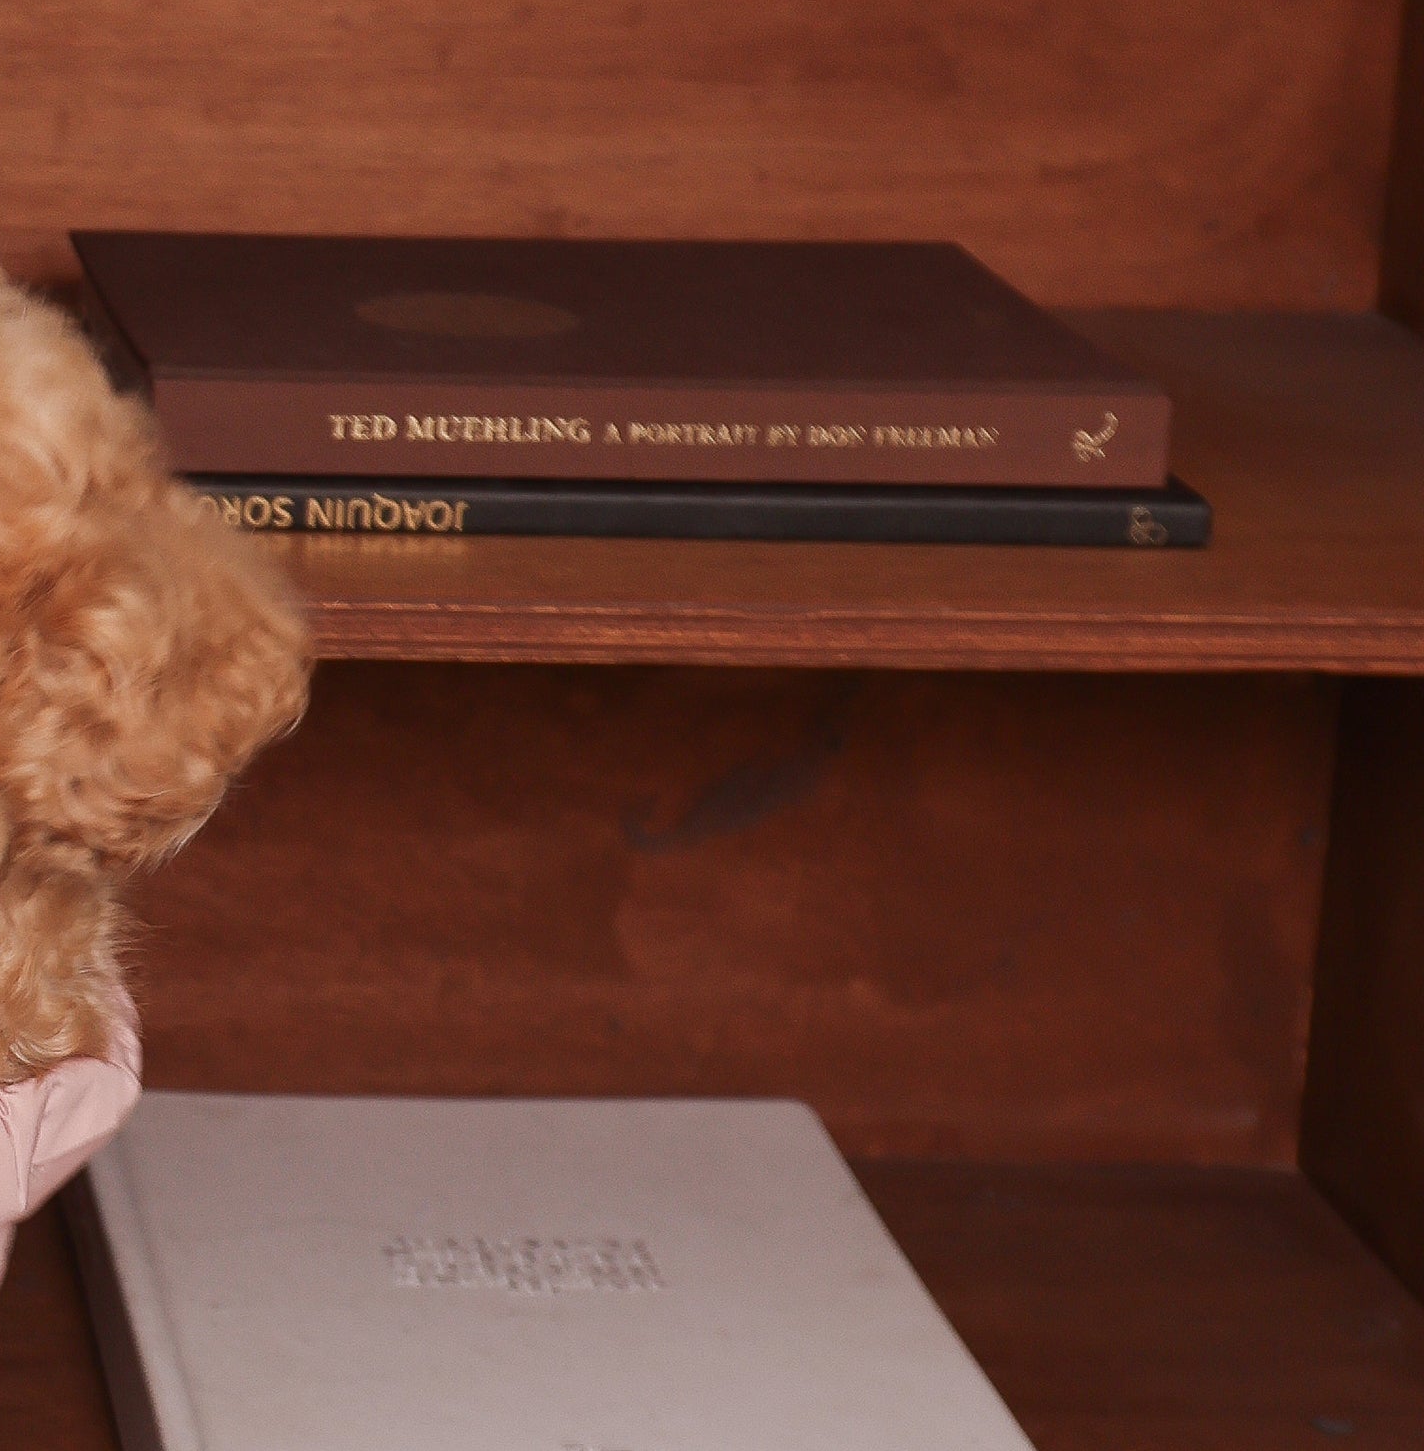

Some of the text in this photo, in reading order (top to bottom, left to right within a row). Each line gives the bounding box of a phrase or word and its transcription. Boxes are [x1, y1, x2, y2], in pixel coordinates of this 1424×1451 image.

[329, 414, 398, 441] TED
[603, 422, 624, 445] A
[627, 420, 760, 446] PORTRAIT
[766, 423, 800, 447] BY
[807, 424, 867, 448] DON
[305, 492, 469, 533] JOAQUIN
